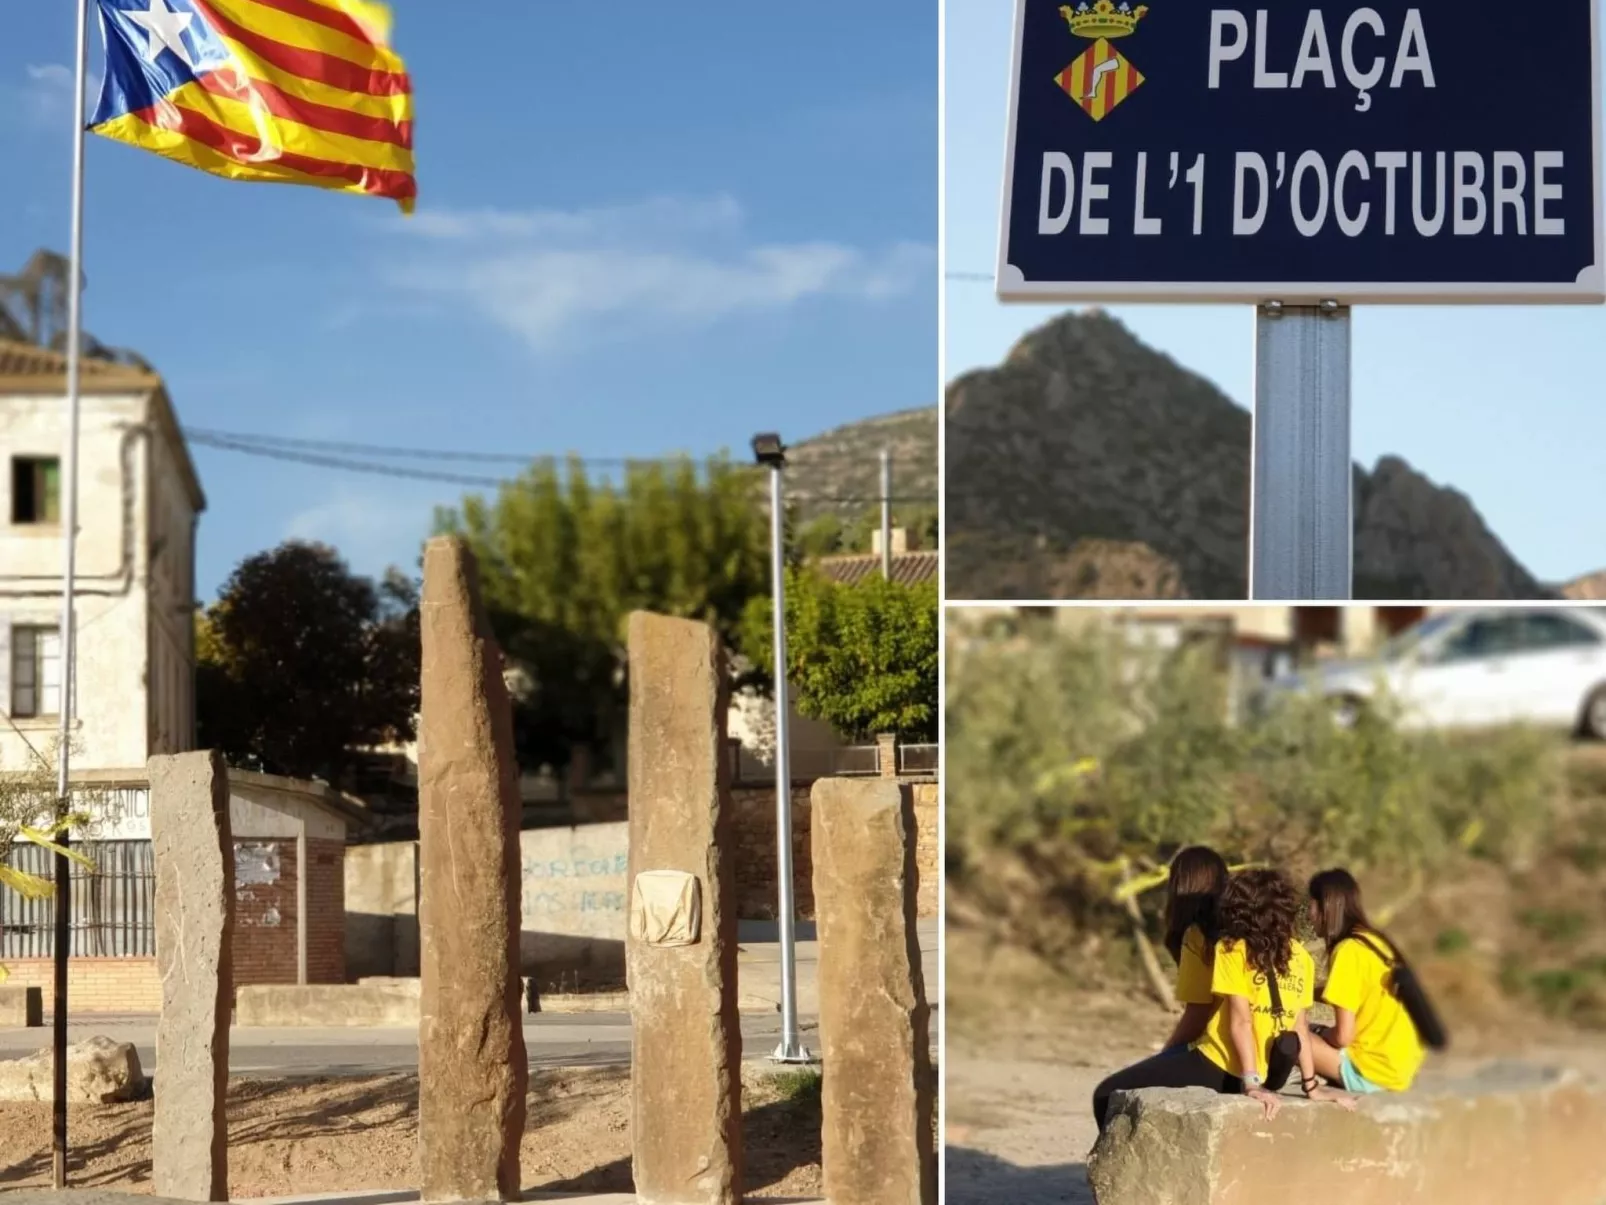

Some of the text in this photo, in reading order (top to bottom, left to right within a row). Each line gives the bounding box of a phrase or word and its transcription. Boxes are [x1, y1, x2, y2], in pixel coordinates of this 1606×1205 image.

[1208, 8, 1435, 111] PLAÇA
[1039, 150, 1564, 237] DE L'1 D'OCTUBRE
